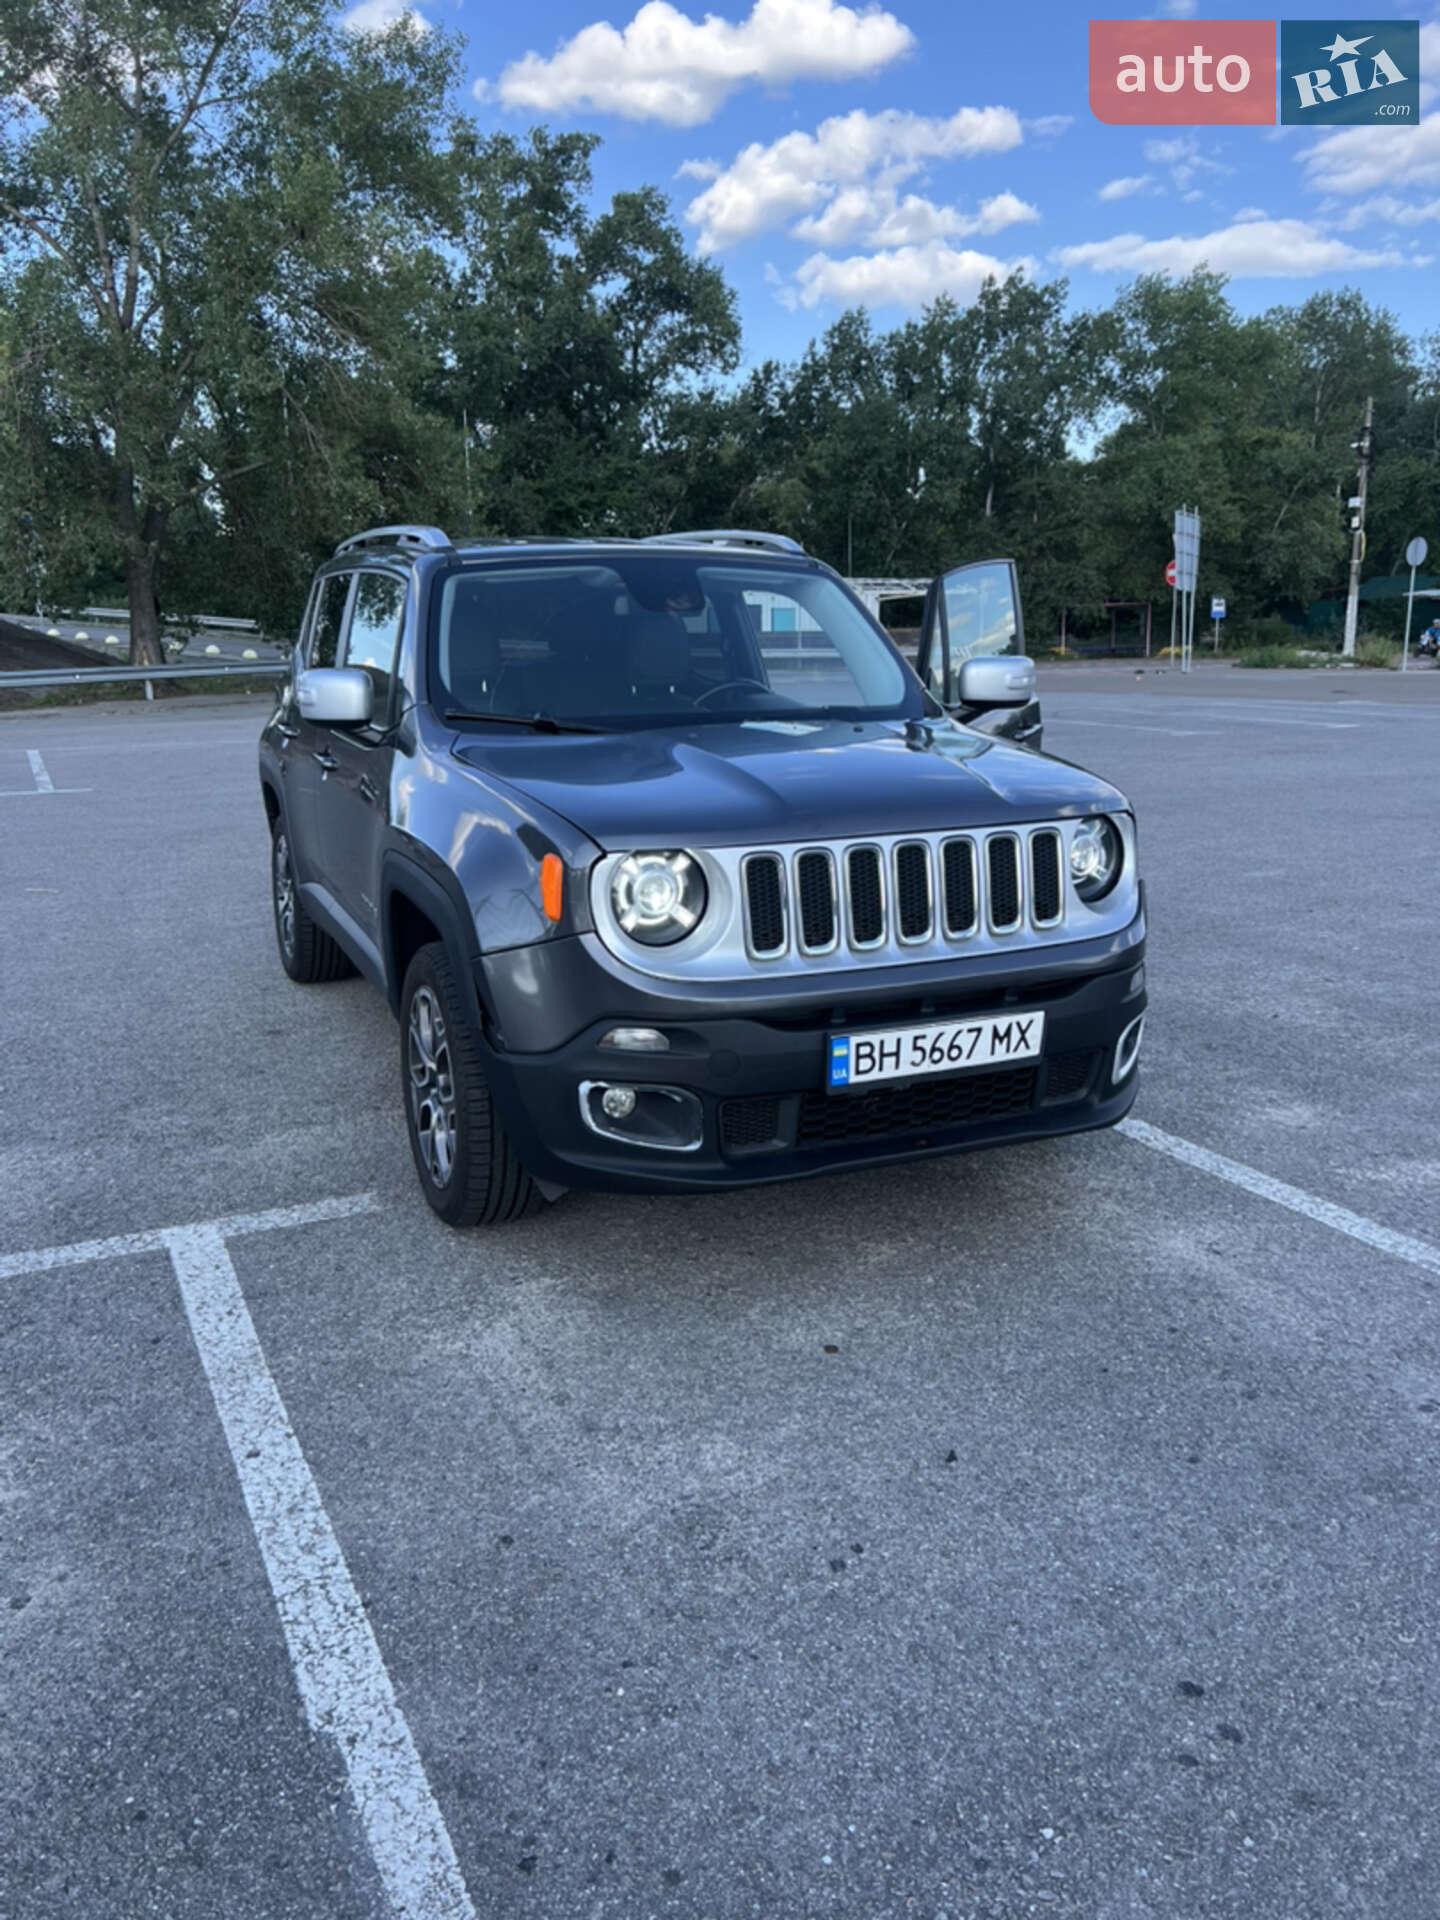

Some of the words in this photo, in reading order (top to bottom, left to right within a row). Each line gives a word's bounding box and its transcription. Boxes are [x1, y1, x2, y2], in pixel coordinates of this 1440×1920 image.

[854, 1037, 901, 1076] BH
[910, 1027, 983, 1067] 5667
[990, 1019, 1034, 1056] MX
[833, 1069, 847, 1079] UA
